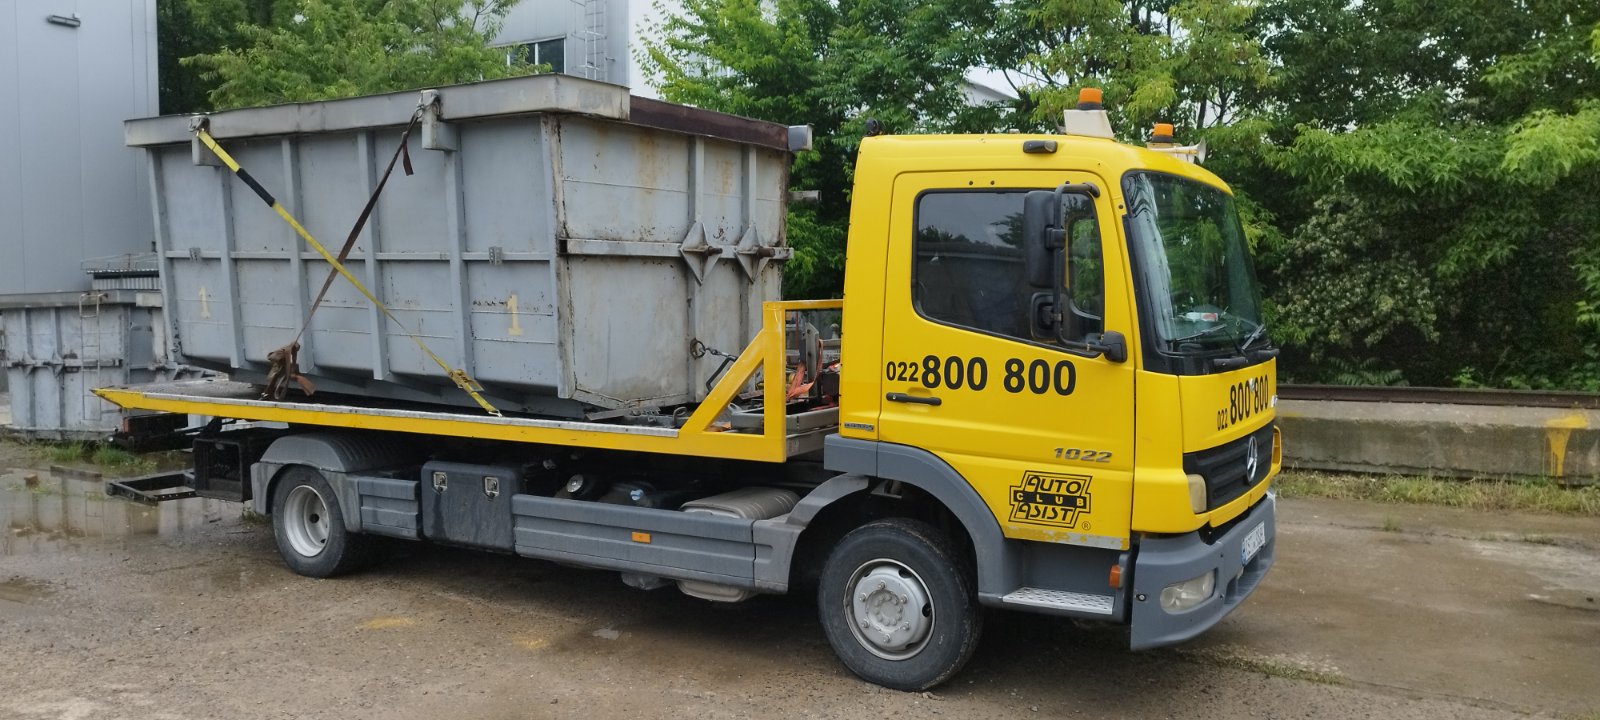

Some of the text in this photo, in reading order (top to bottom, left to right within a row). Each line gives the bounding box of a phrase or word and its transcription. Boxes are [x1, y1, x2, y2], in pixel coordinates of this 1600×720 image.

[198, 287, 211, 318] 1
[507, 293, 523, 336] 1
[886, 355, 1077, 396] 022 800 800
[1217, 374, 1269, 431] 022 800 800
[1054, 448, 1112, 463] 1022
[1027, 475, 1081, 494] AUTO
[1016, 492, 1084, 506] CLUB
[1017, 502, 1073, 521] ASIST
